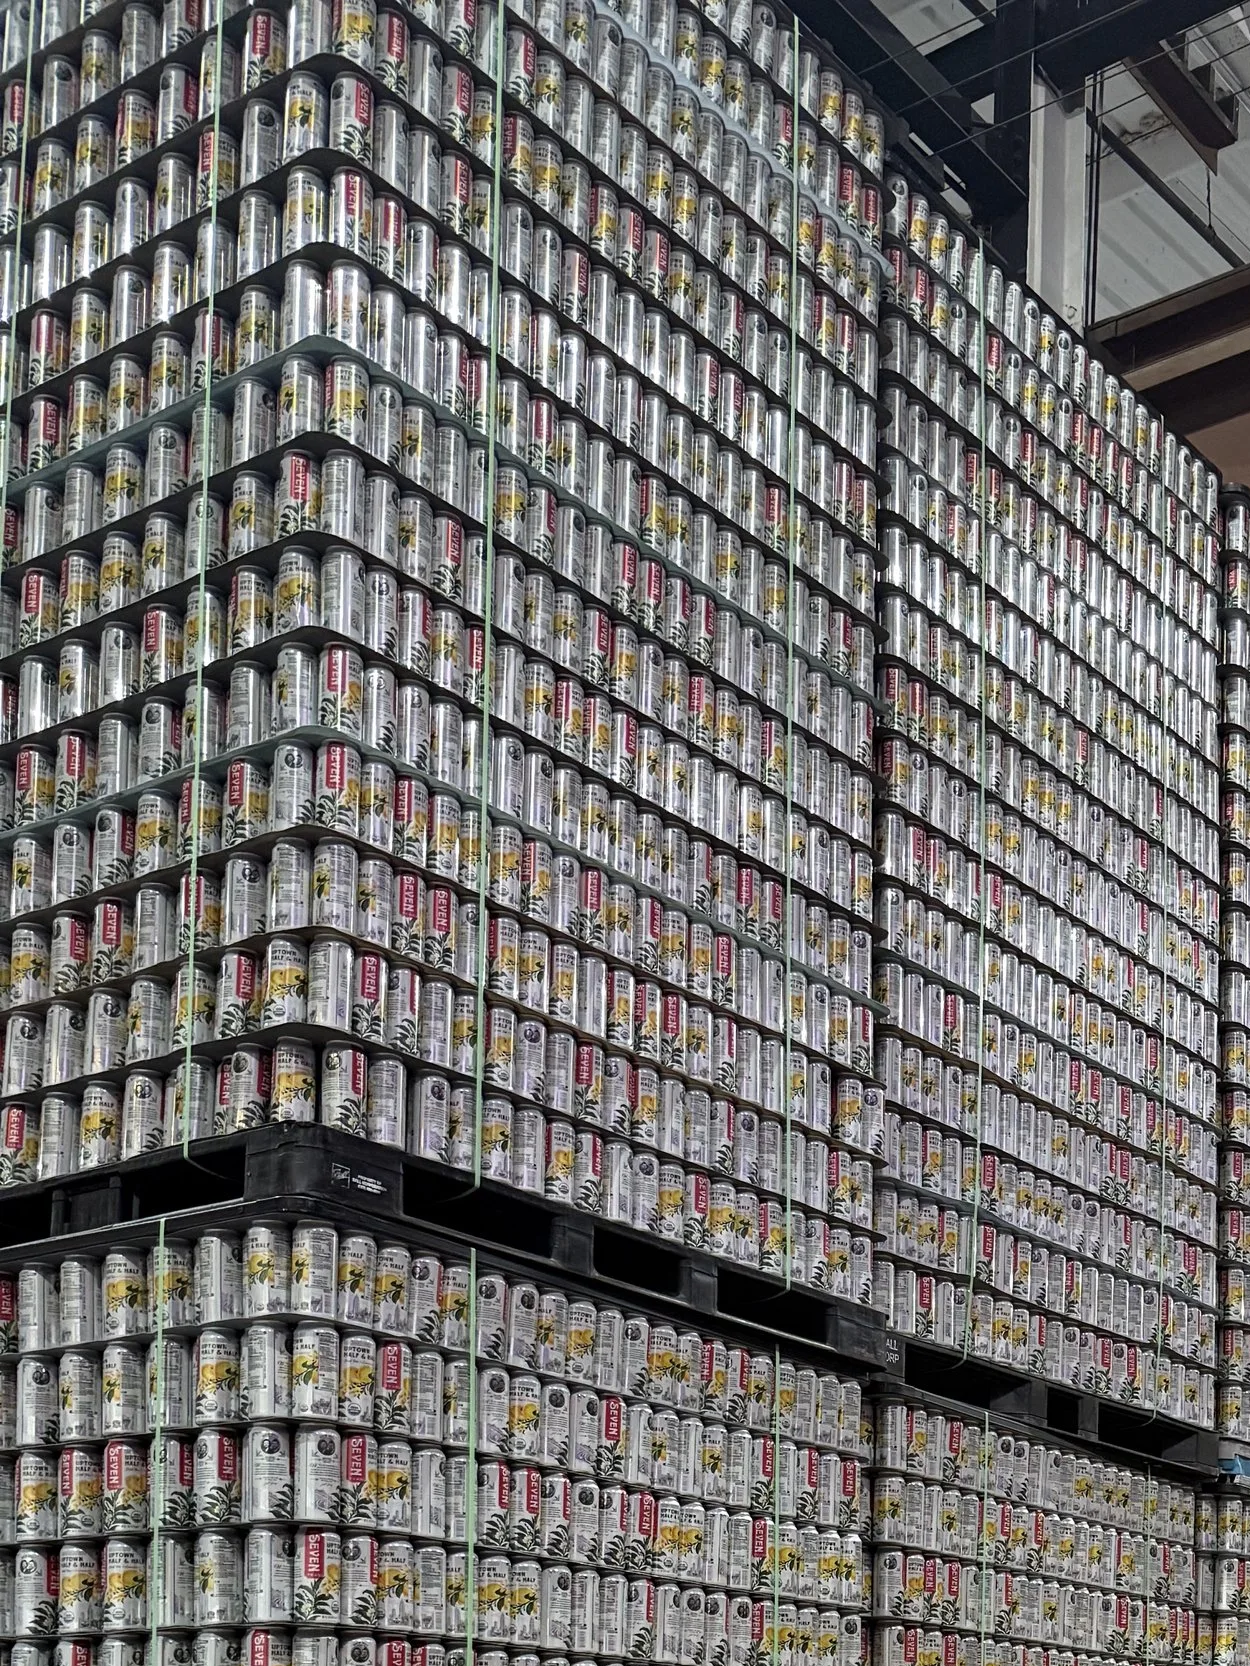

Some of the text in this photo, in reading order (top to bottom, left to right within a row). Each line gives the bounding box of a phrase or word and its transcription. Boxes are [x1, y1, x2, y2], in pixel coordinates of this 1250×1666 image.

[147, 612, 157, 646] SEVEN
[628, 717, 636, 752] SEVEN
[231, 765, 240, 800] SEVEN
[402, 876, 414, 916] SEVEN
[436, 890, 448, 926] SEVEN
[106, 904, 117, 940] SEVEN
[718, 937, 728, 970] SEVEN
[239, 957, 252, 994] SEVEN
[364, 957, 377, 994] SEVEN
[668, 997, 676, 1028] SEVEN
[579, 1047, 590, 1080] SEVEN
[8, 1109, 21, 1142] SEVEN
[698, 1176, 707, 1208] SEVEN
[386, 1345, 398, 1384] SEVEN
[609, 1400, 618, 1436] SEVEN
[109, 1446, 119, 1484] SEVEN
[223, 1437, 233, 1474] SEVEN
[350, 1436, 362, 1476] SEVEN
[530, 1471, 539, 1508] SEVEN
[846, 1463, 854, 1492] SEVEN
[308, 1535, 320, 1572] SEVEN
[754, 1520, 764, 1552] SEVEN
